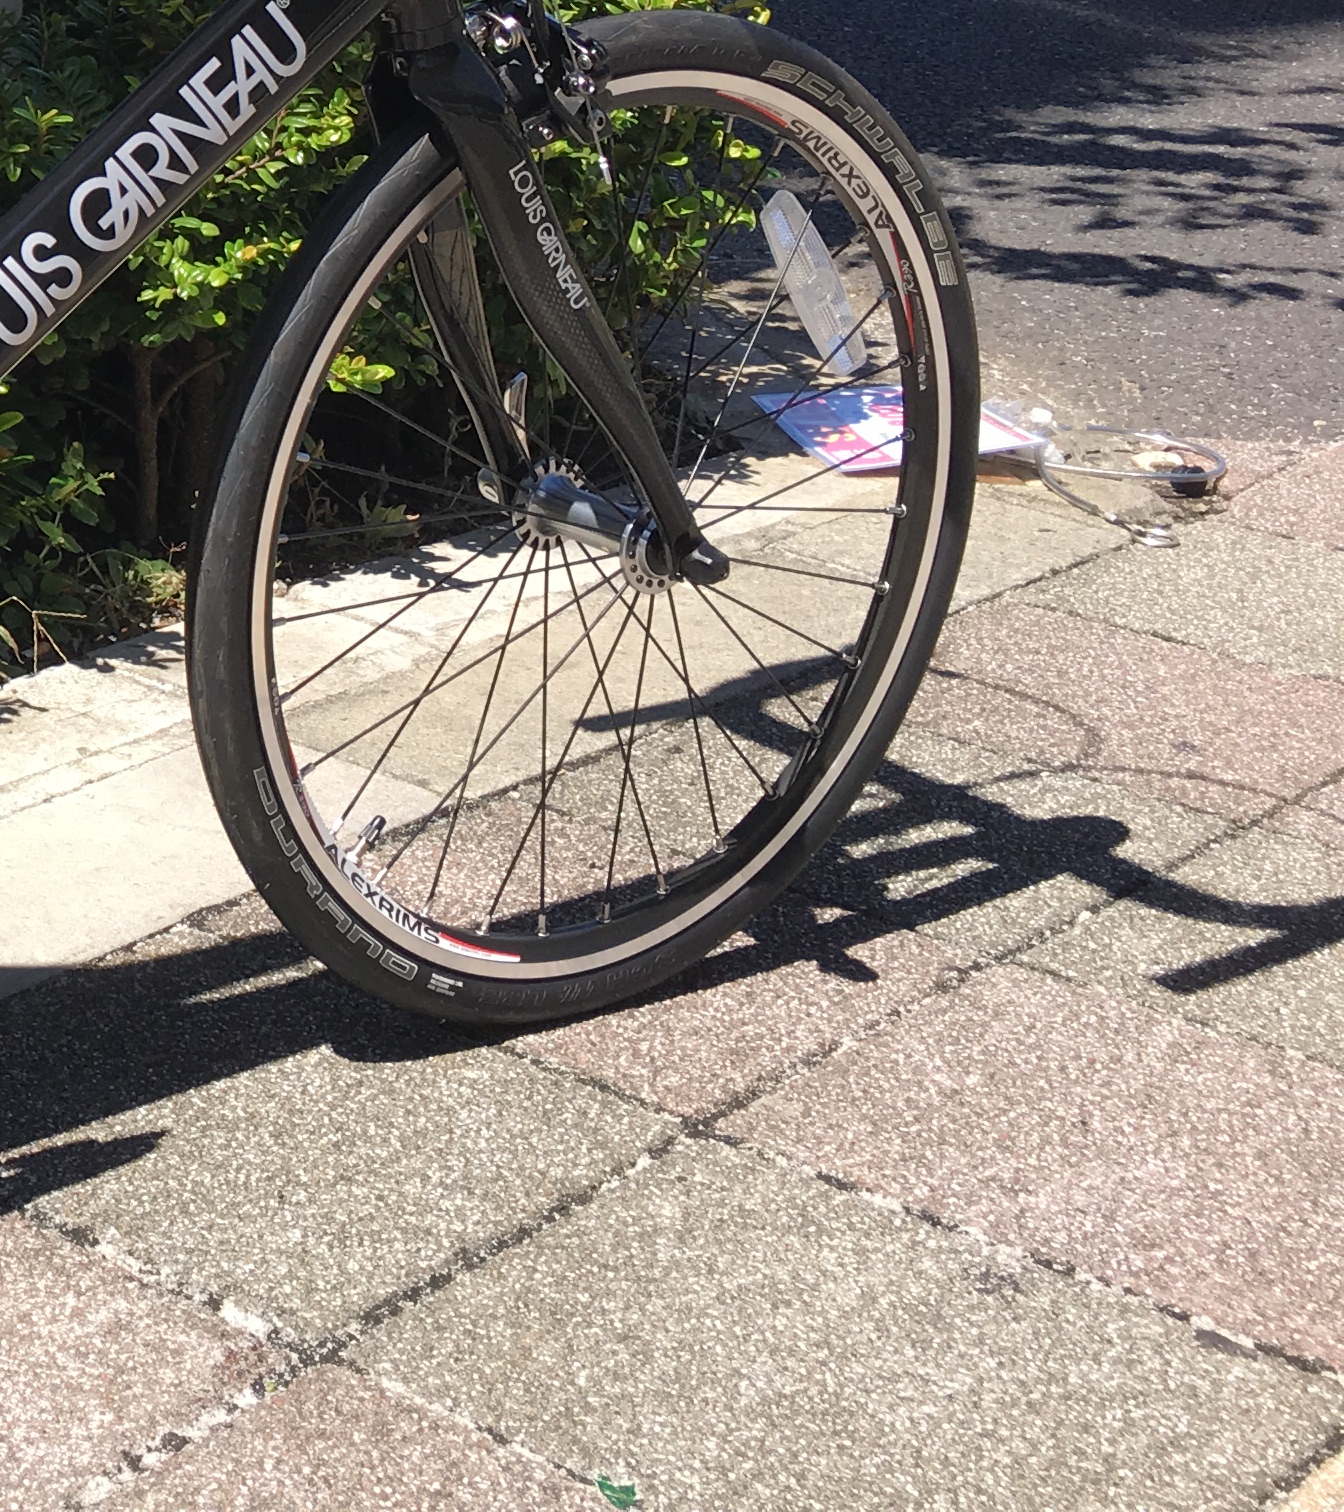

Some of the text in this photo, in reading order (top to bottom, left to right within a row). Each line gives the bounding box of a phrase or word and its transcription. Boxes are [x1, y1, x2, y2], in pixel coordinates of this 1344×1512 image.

[69, 0, 308, 253] GARNEAU
[763, 61, 959, 287] SCHWALBE
[787, 118, 893, 233] ALEXRIMS
[508, 159, 587, 311] LOUIS GARNEAU
[252, 766, 419, 983] DURANO
[325, 842, 443, 946] ALEXRIMS
